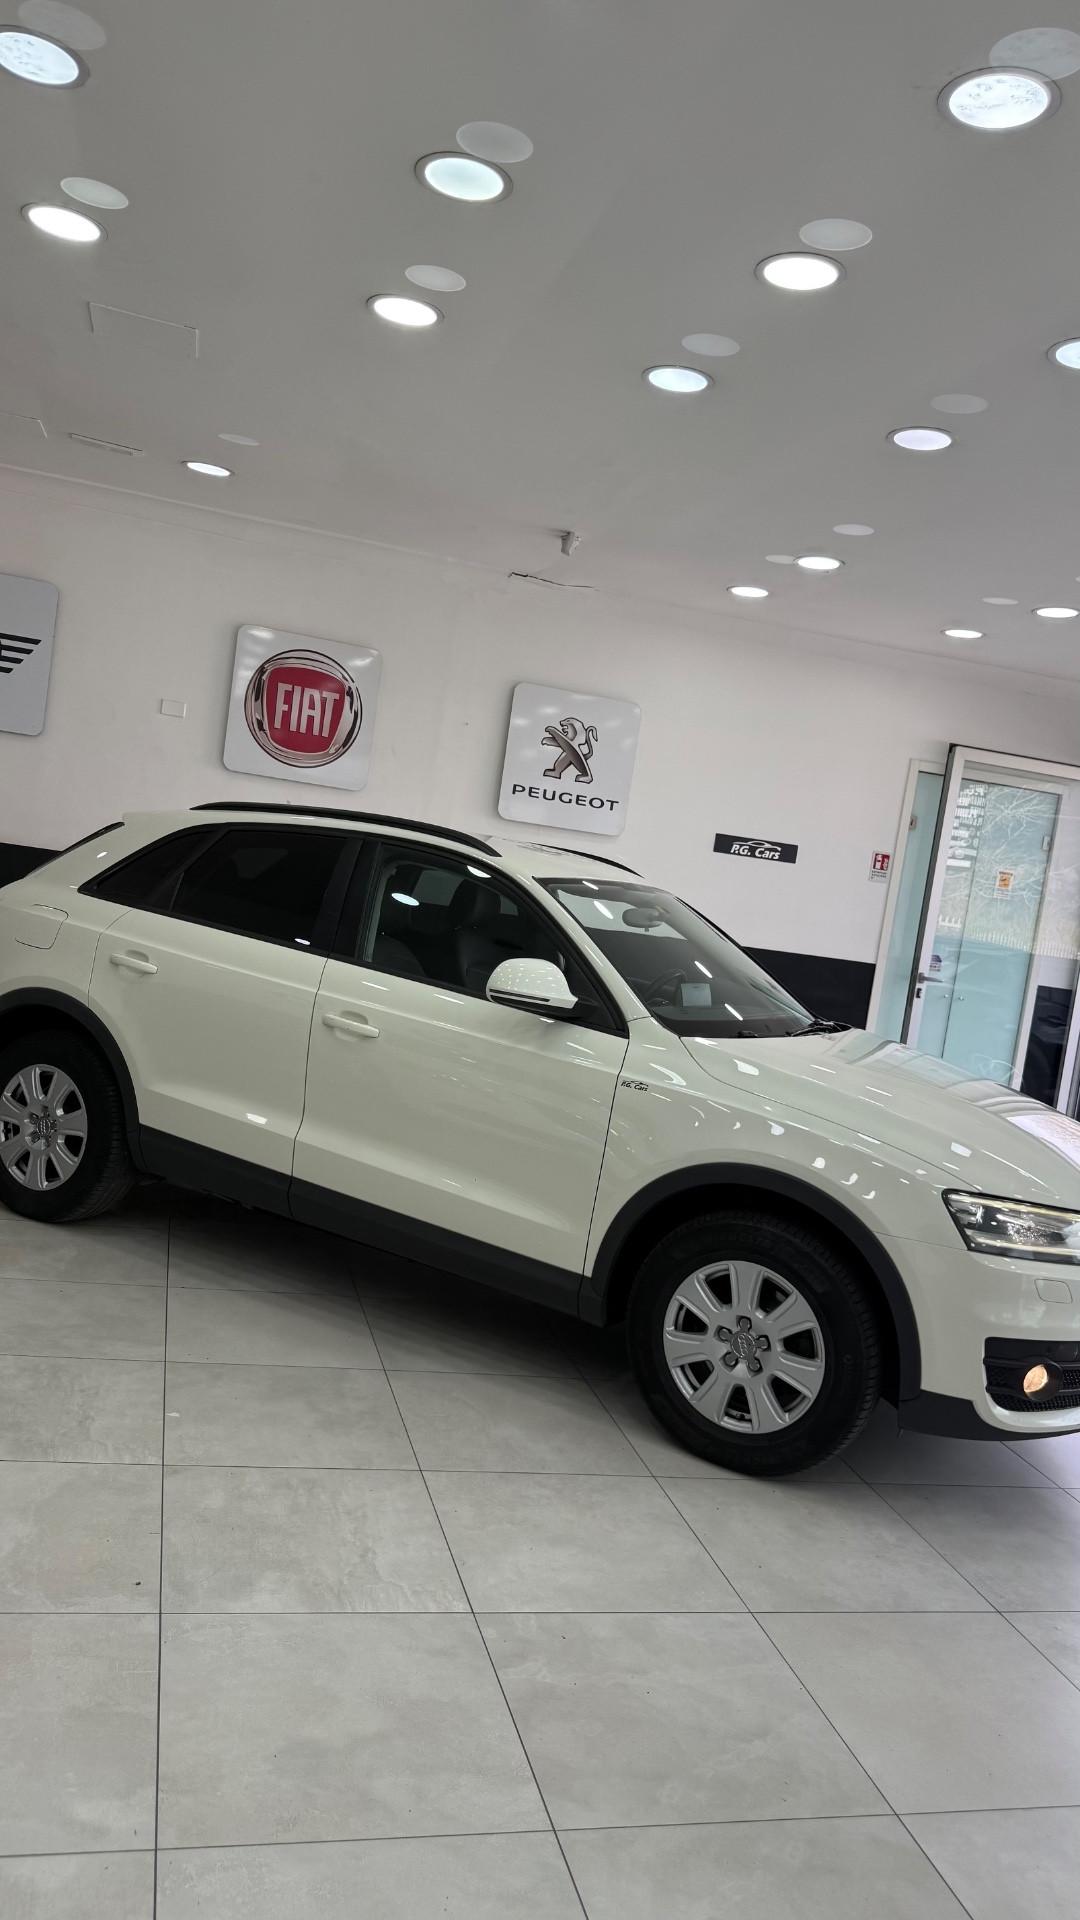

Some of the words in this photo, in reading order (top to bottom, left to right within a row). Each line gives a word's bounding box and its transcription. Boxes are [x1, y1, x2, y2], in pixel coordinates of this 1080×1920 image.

[274, 683, 340, 737] FIAT
[512, 784, 619, 811] PEUGEOT
[730, 844, 751, 856] P.G.
[755, 848, 781, 859] Cars
